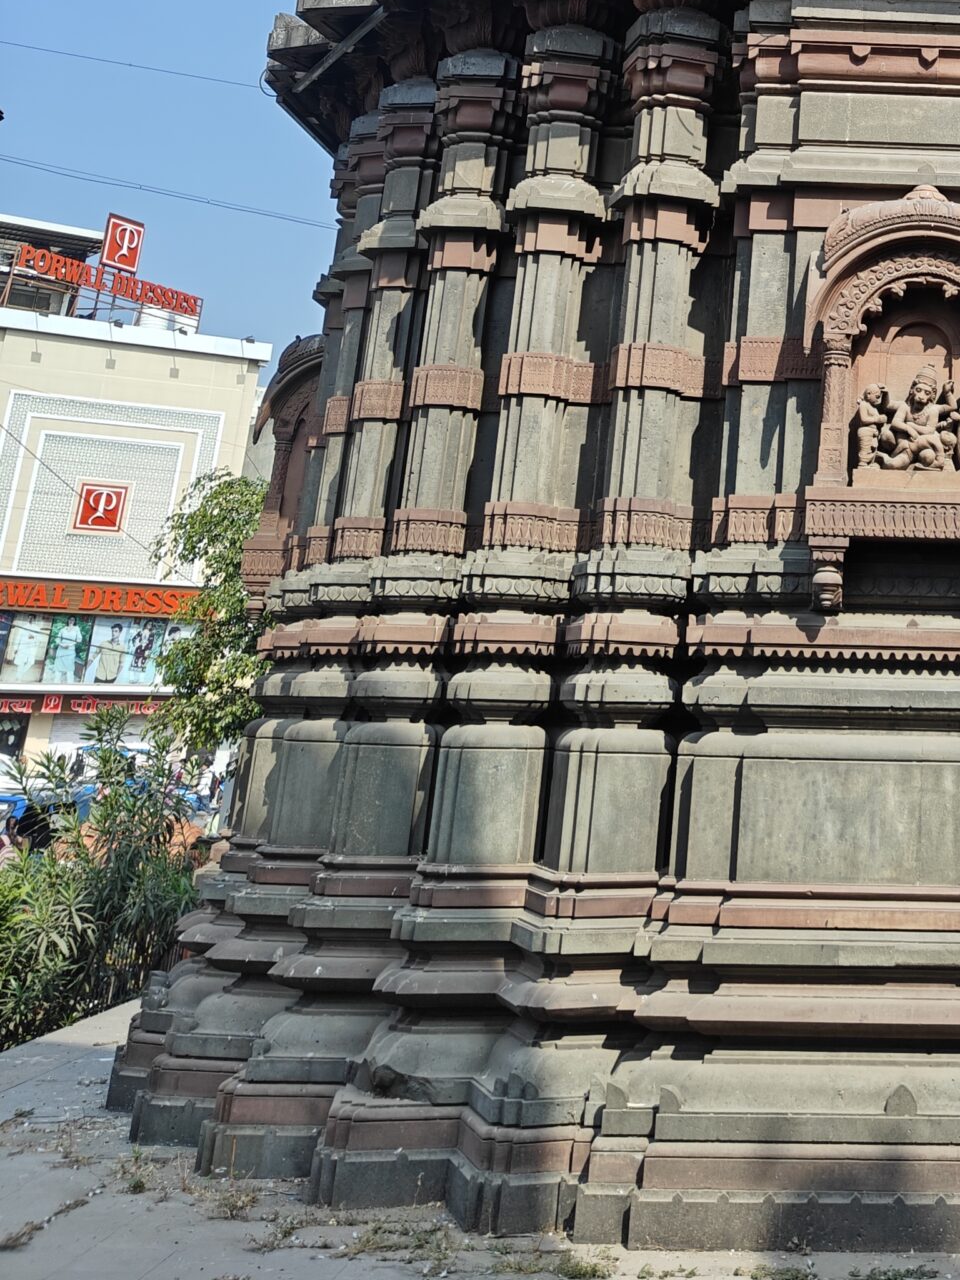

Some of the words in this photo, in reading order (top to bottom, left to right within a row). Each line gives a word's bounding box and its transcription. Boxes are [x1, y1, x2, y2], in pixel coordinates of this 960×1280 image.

[18, 244, 108, 291] PORWAL
[111, 272, 199, 316] DRESSES
[0, 581, 69, 609] WAL
[79, 584, 216, 616] DRESS
